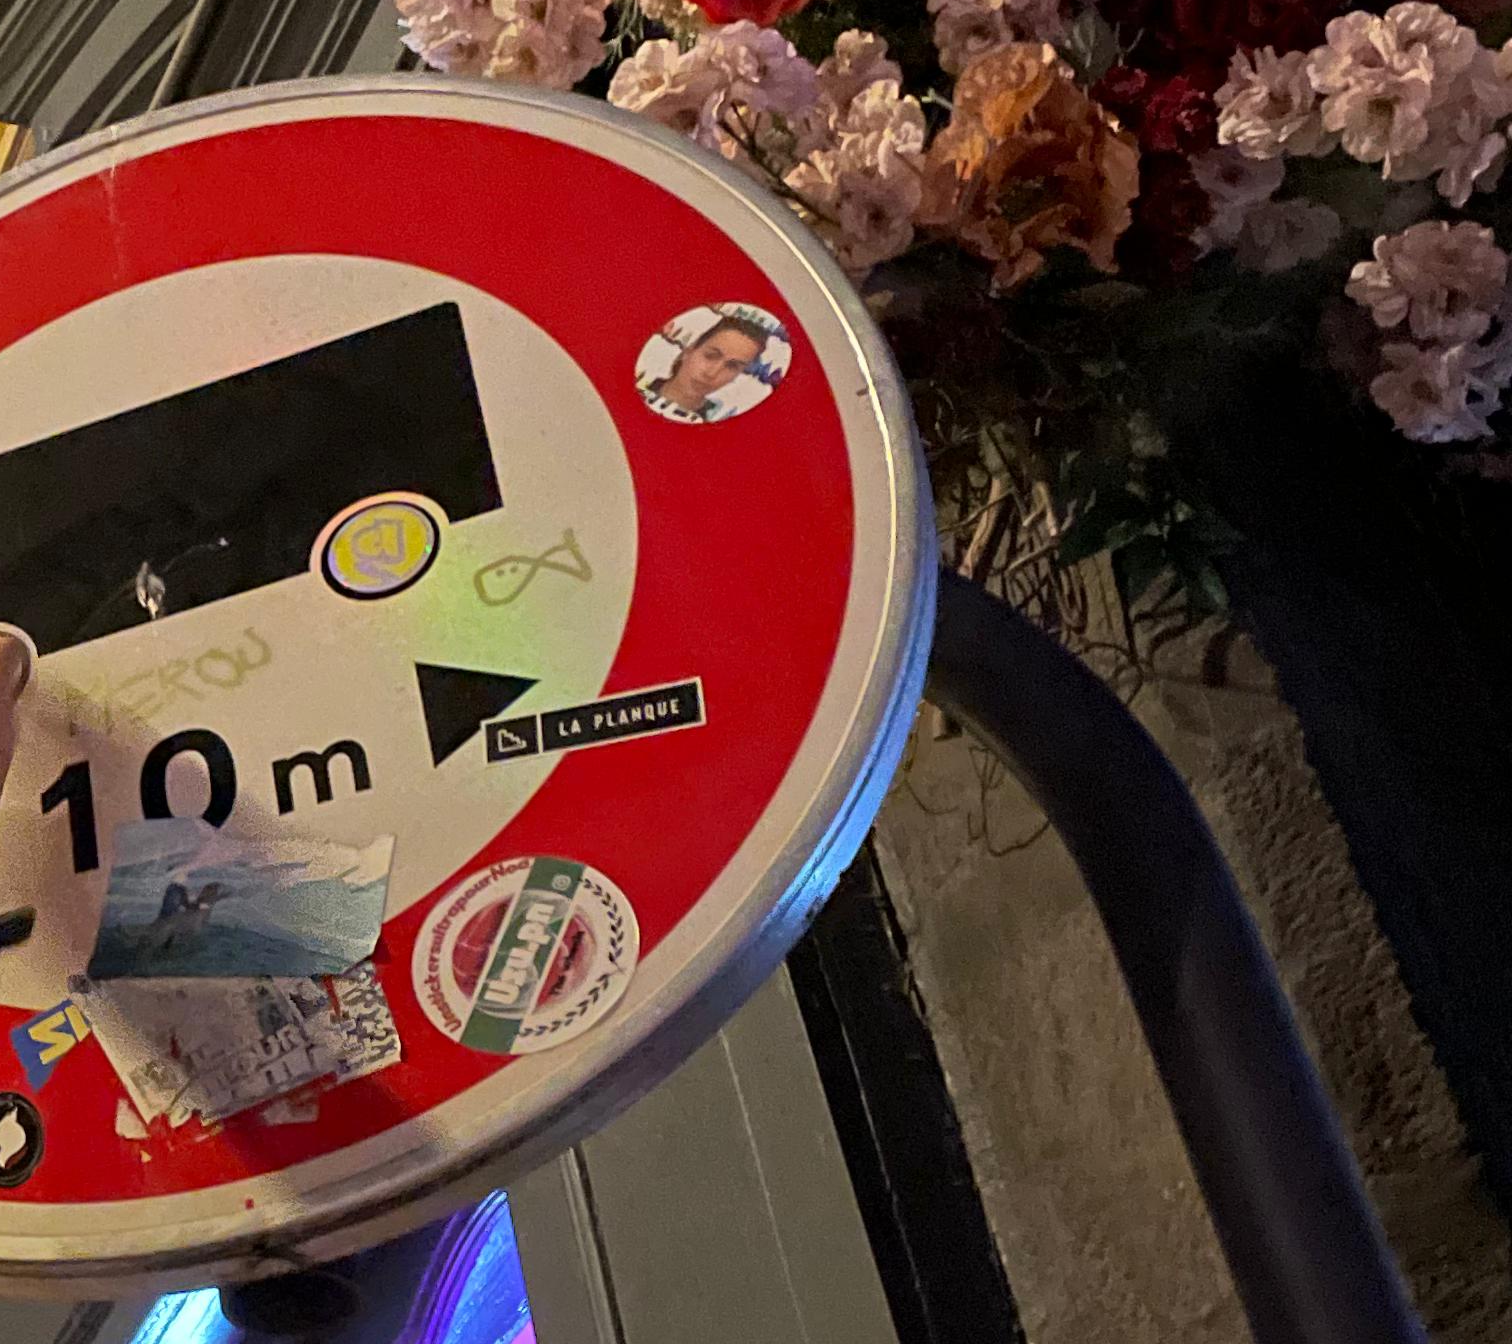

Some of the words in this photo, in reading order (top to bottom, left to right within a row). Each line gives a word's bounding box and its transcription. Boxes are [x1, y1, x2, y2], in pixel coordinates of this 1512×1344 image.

[557, 717, 582, 737] LA
[592, 697, 681, 730] PLANQUE
[40, 728, 237, 875] 10
[271, 739, 373, 817] m
